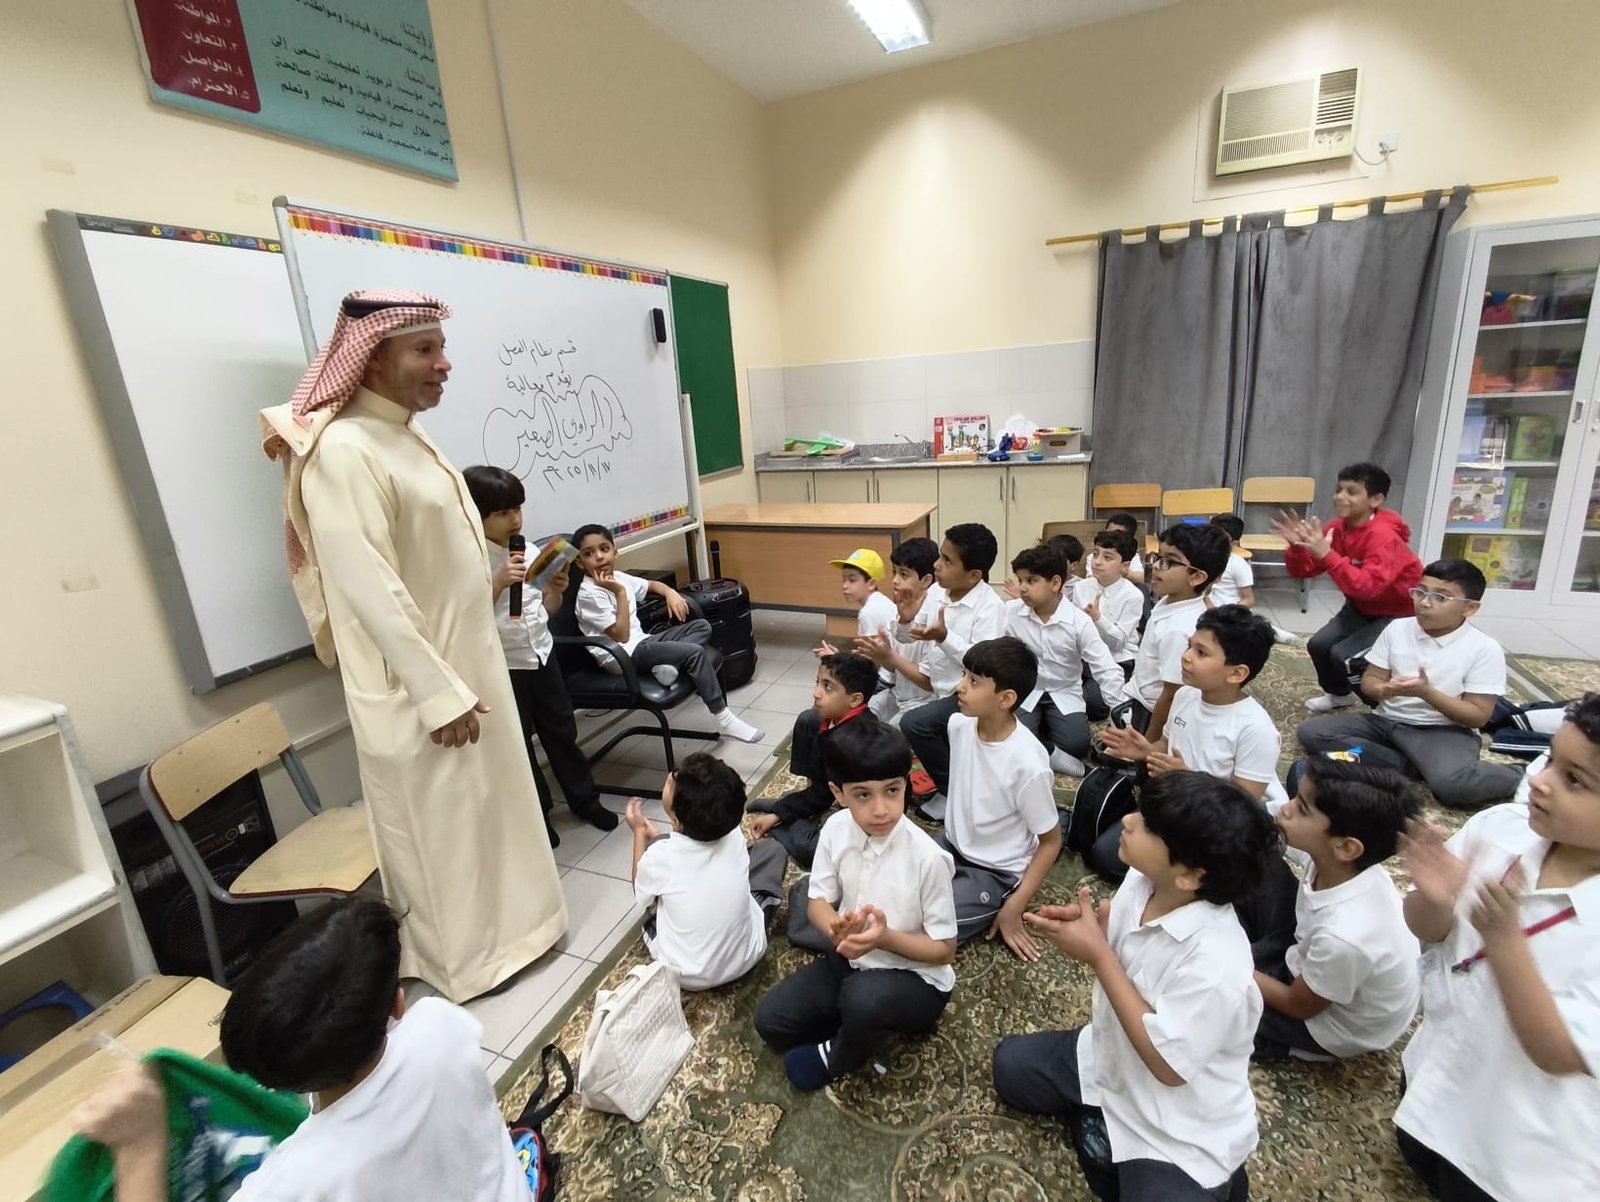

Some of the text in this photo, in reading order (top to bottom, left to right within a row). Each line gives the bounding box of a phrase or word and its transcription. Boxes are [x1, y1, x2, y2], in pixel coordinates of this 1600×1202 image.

[181, 28, 227, 49] التعاون
[179, 51, 233, 73] التواصل
[497, 337, 528, 367] الفصل
[556, 339, 577, 370] قسم
